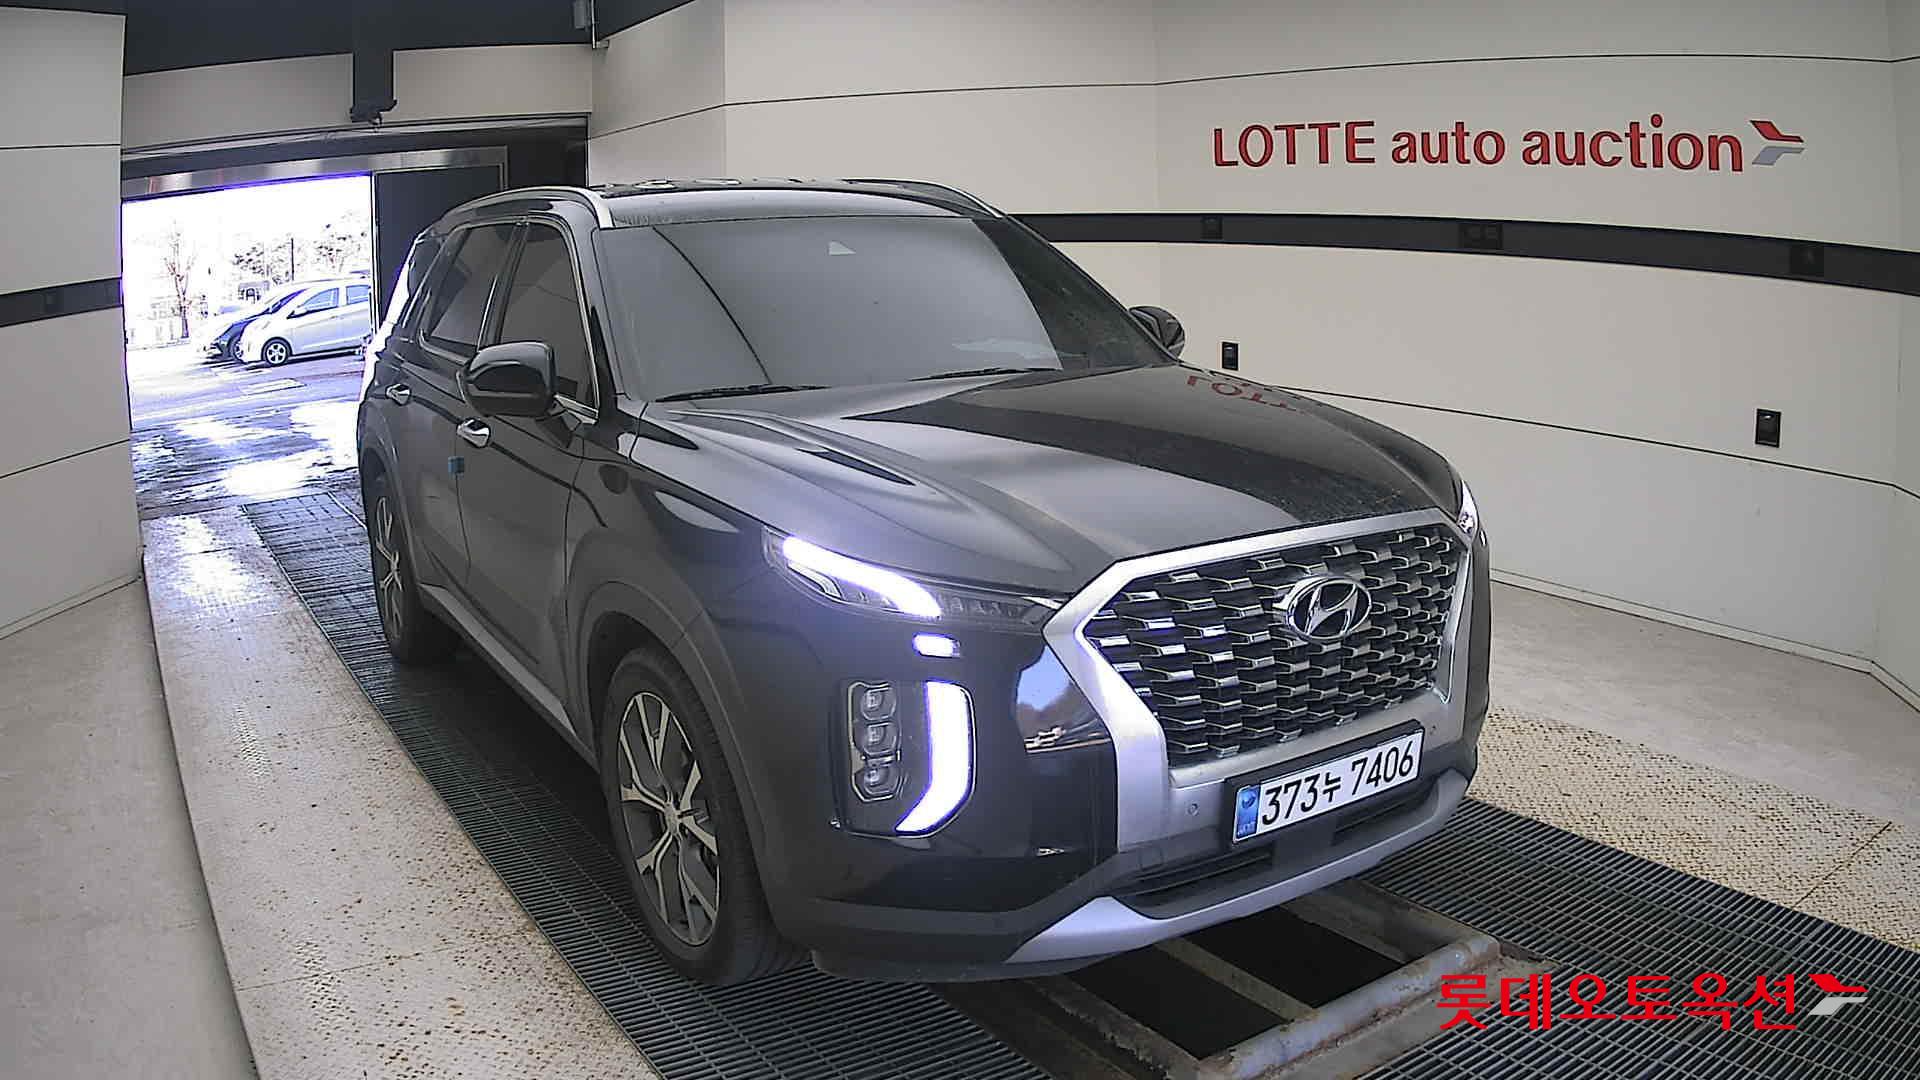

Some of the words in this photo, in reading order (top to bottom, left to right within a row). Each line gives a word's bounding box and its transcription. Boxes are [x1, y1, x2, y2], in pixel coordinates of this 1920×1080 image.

[1213, 120, 1377, 168] LOTTE
[1391, 121, 1506, 166] auto
[1522, 113, 1745, 174] auction
[1261, 771, 1341, 825] 373누
[1351, 740, 1414, 796] 7406
